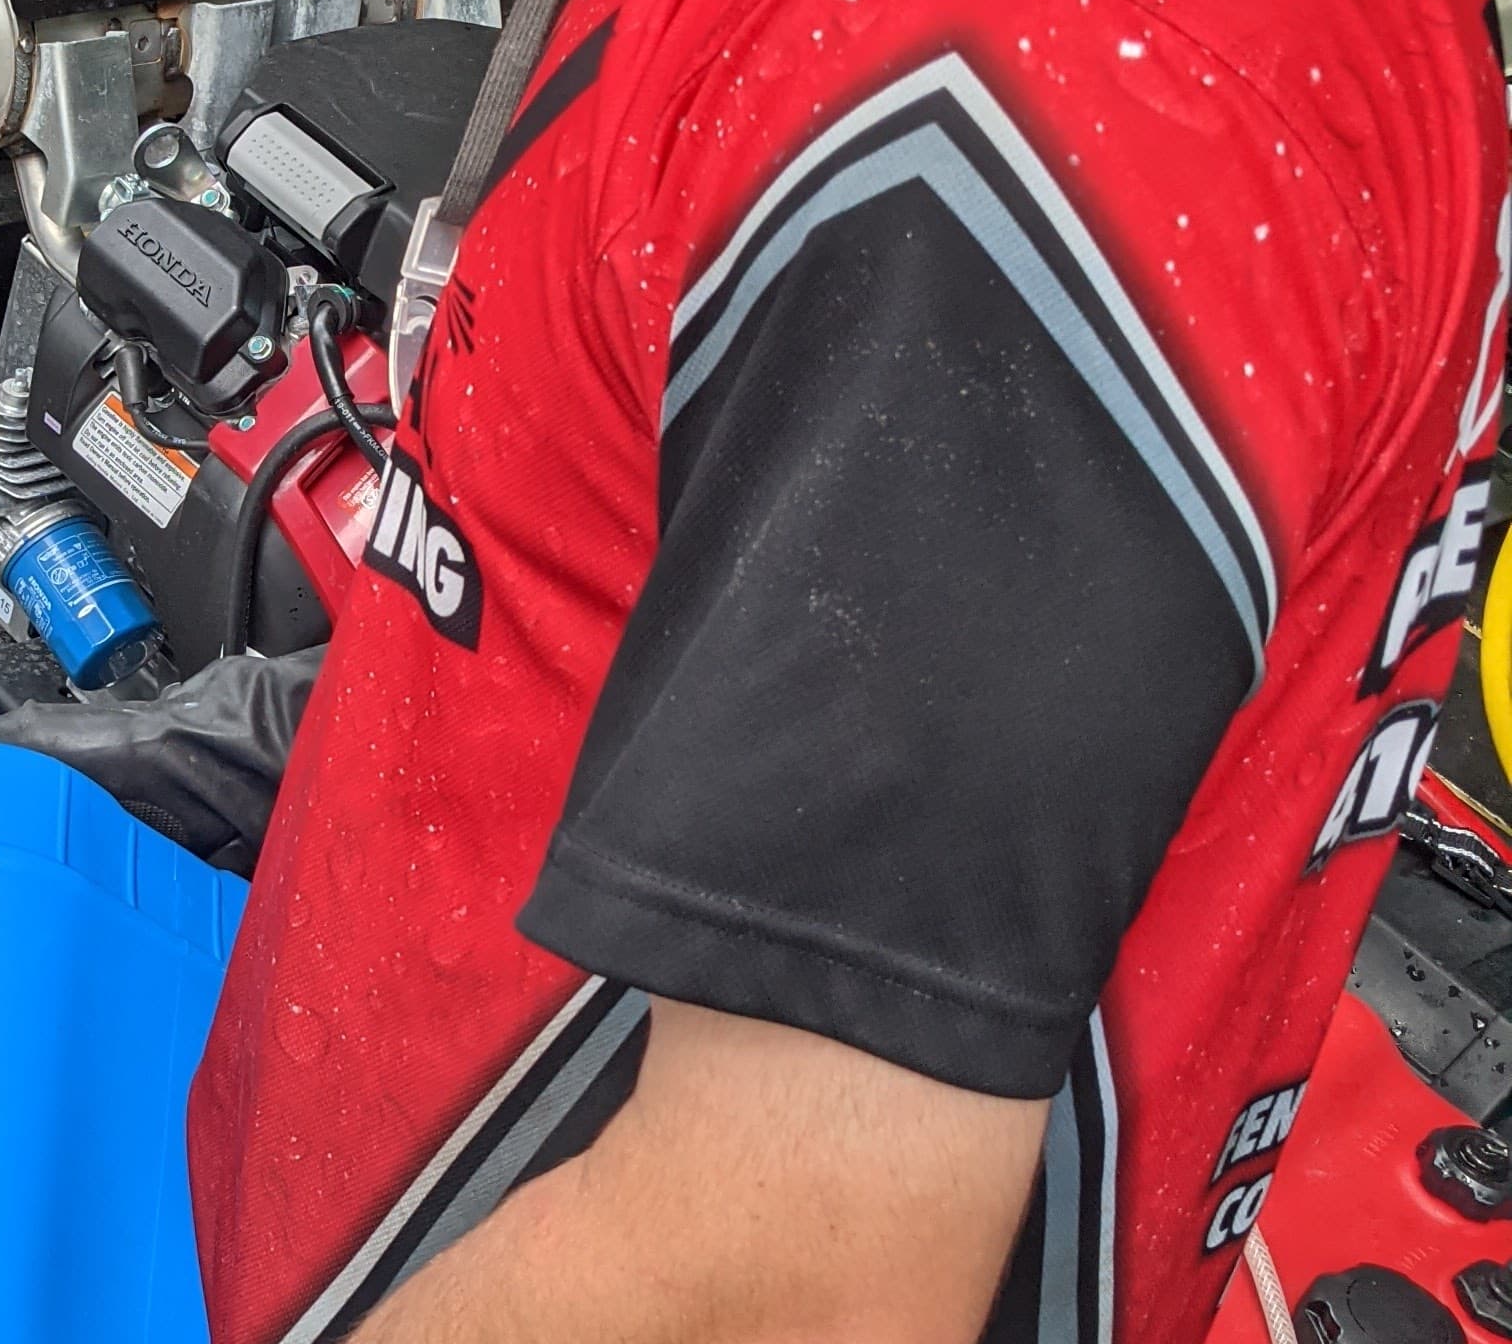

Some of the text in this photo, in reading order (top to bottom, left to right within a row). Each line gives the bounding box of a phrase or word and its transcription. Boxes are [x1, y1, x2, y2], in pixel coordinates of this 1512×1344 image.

[116, 219, 212, 308] HONDA
[368, 458, 466, 618] ING
[29, 575, 52, 613] HONDA
